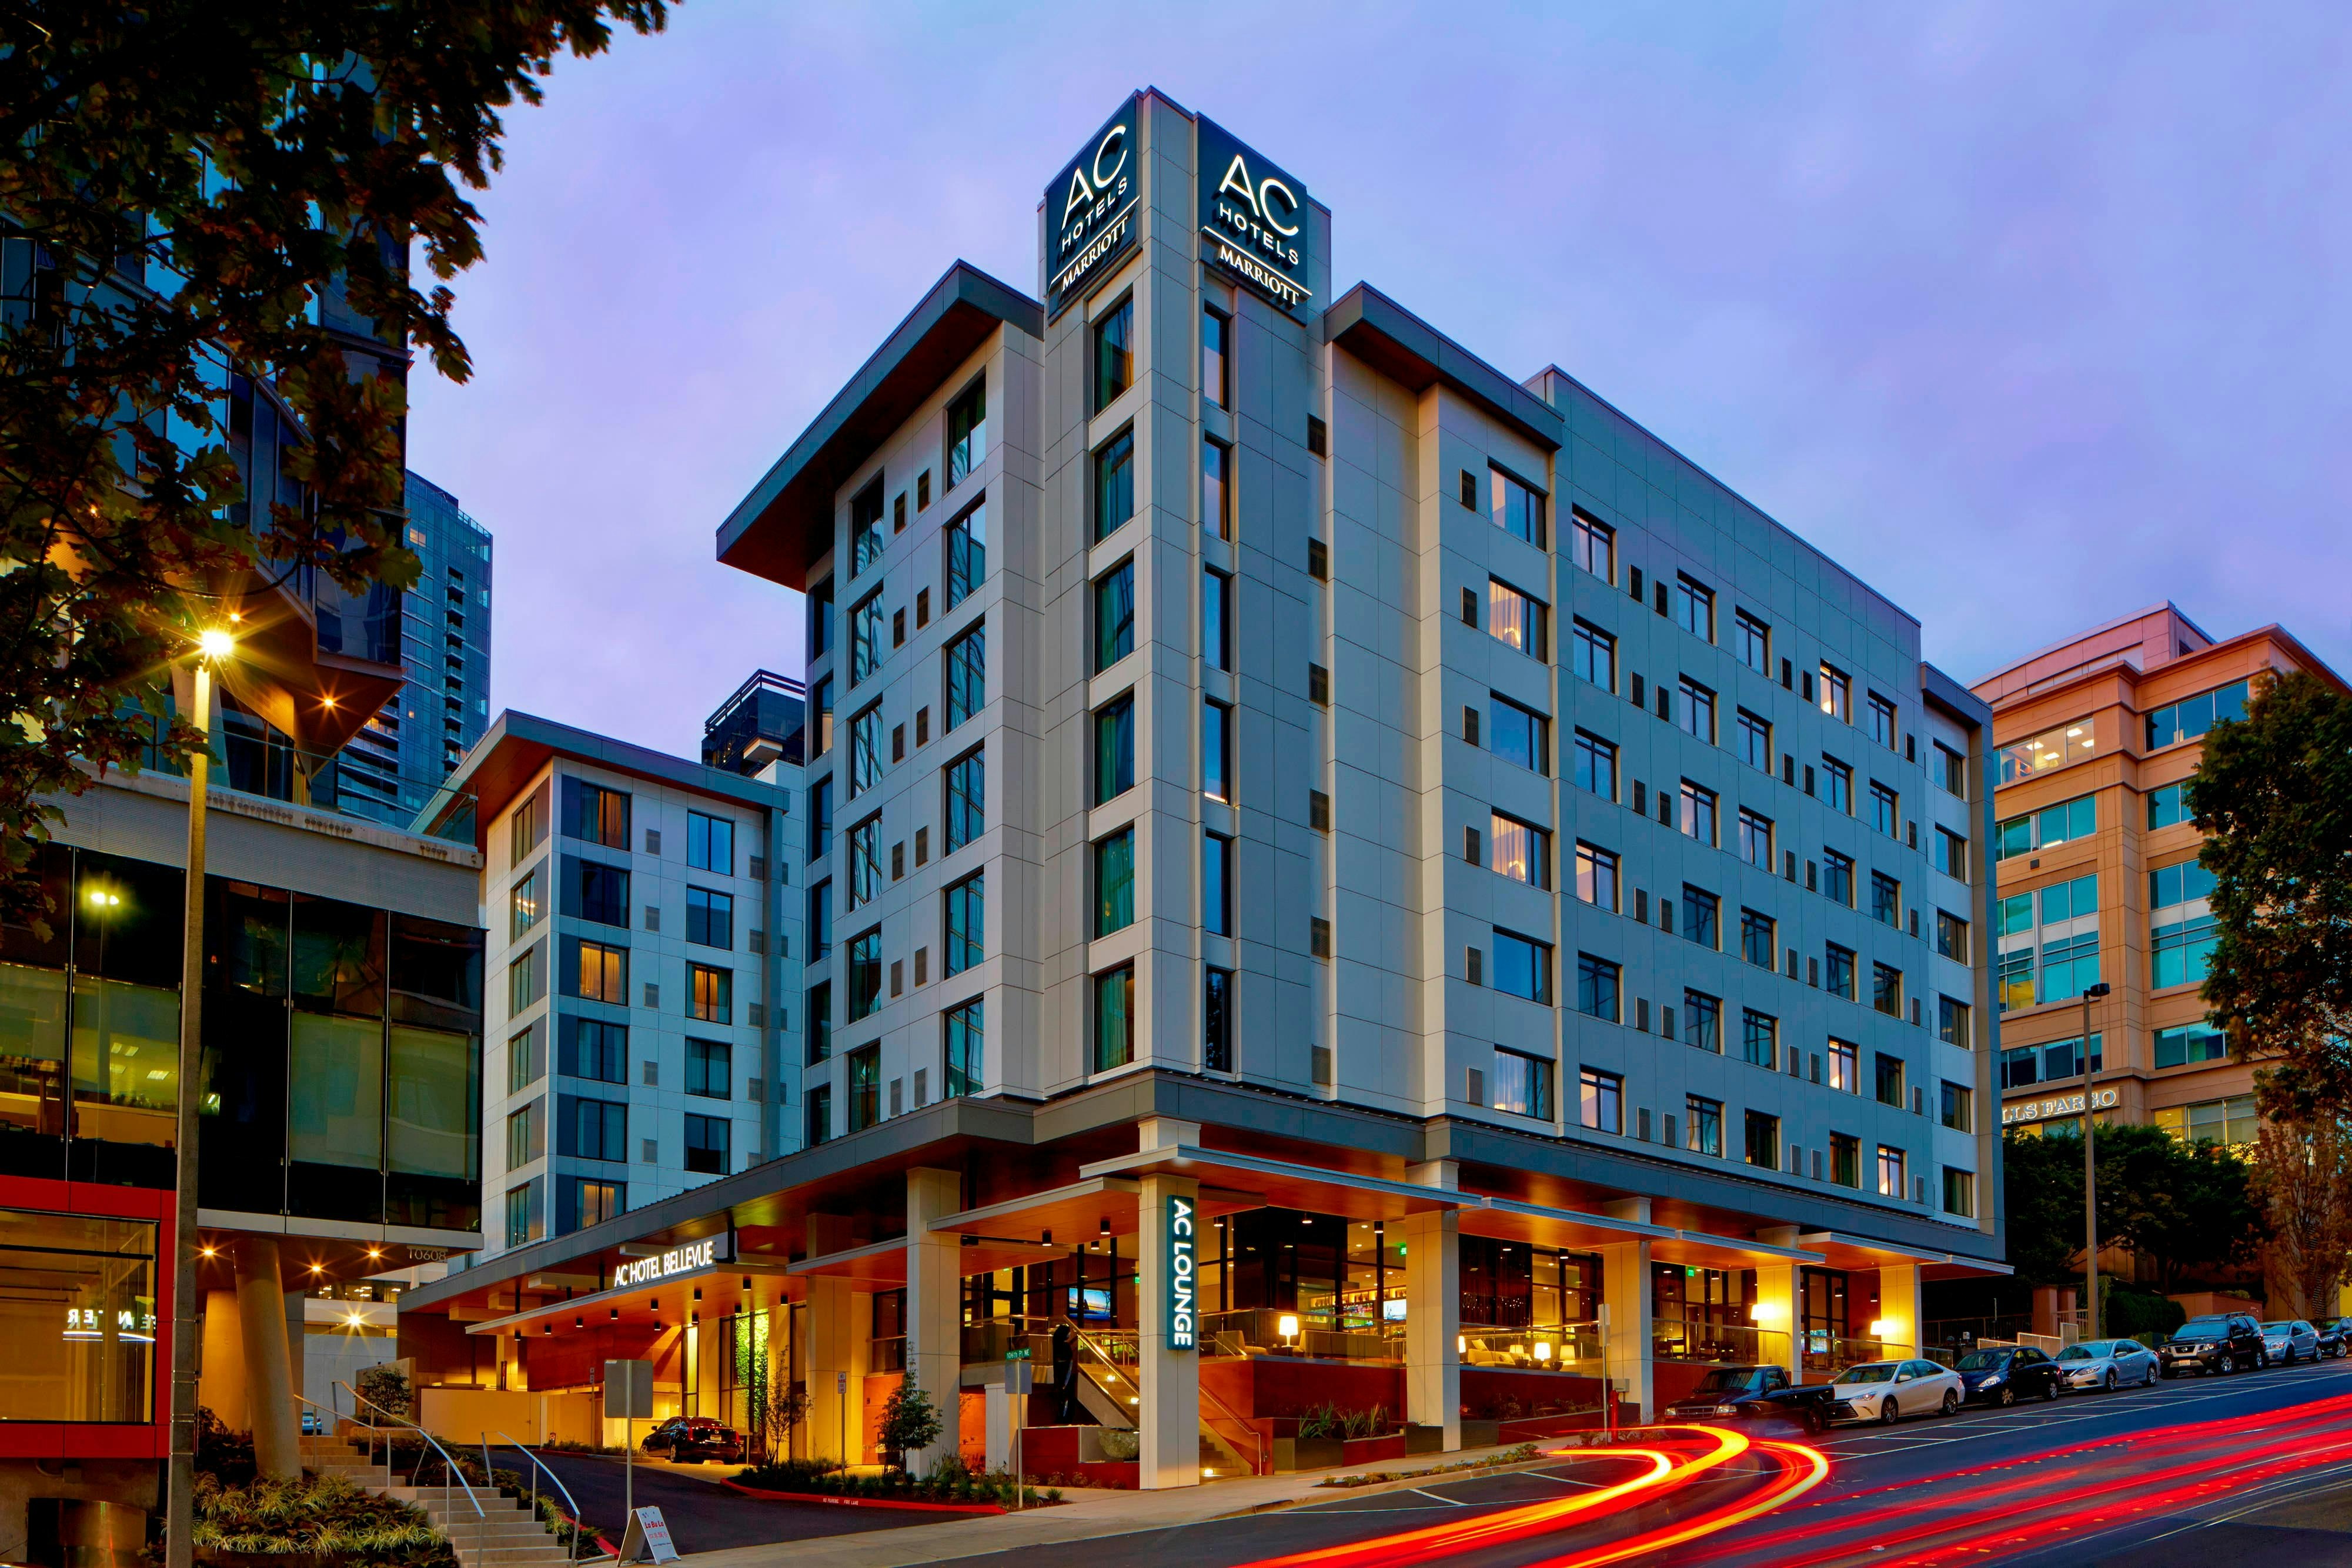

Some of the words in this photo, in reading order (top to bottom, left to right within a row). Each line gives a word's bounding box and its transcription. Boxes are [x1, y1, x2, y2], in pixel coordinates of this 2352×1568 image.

[1062, 125, 1127, 230] AC
[1219, 154, 1299, 236] AC
[1062, 176, 1127, 252] HOTELS
[1220, 202, 1299, 265] HOTELS
[1062, 215, 1128, 292] MARRIOTT
[1220, 245, 1299, 306] MARRIOTT
[2002, 1103, 2037, 1124] LLS
[1174, 1199, 1191, 1236] AC
[409, 1249, 446, 1261] 10608
[614, 1265, 628, 1287] AC
[630, 1256, 662, 1283] HOTEL
[663, 1241, 713, 1276] BELLEVUE
[1174, 1242, 1192, 1346] LOUNGE
